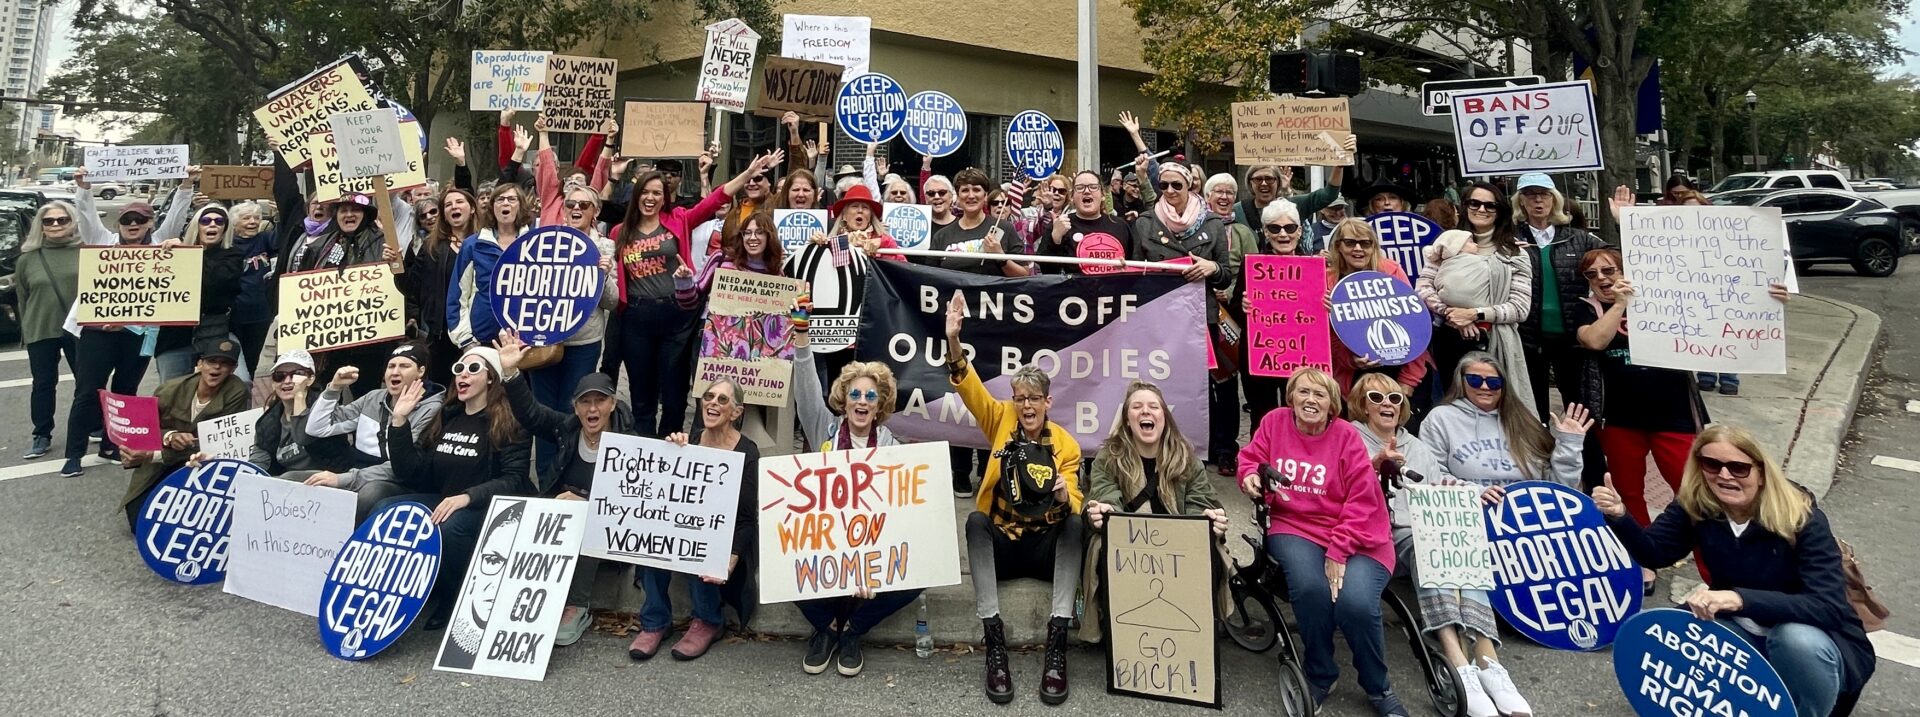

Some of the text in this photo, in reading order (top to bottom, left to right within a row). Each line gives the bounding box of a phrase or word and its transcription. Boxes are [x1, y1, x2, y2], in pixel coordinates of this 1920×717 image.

[794, 21, 820, 31] Where
[730, 34, 749, 50] WILL
[475, 52, 544, 68] Reproductive
[711, 46, 751, 67] NEVER
[492, 64, 530, 82] Rights
[550, 58, 614, 76] NO WOMAN
[474, 77, 545, 92] are Human
[554, 73, 607, 88] CAN CALL
[764, 68, 843, 106] VASECTOMY
[850, 75, 892, 95] KEEP
[268, 70, 342, 113] QUAKERS
[489, 90, 544, 110] Rights!
[545, 86, 611, 99] HERSELF FREE
[544, 98, 584, 108] WHEN SHE
[840, 93, 904, 115] ABORTION
[915, 94, 953, 111] KEEP
[1237, 102, 1346, 117] ONE will
[1464, 92, 1550, 114] BANS
[269, 100, 315, 128] UNITE
[346, 114, 372, 126] KEEP
[545, 108, 611, 118] CONTROL HER
[847, 112, 900, 132] LEGAL
[905, 109, 963, 131] ABORTION
[1017, 114, 1049, 131] KEEP
[1237, 115, 1344, 130] have an ABORTION
[360, 126, 383, 134] YOUR
[546, 118, 605, 132] OWN BODY
[1251, 130, 1274, 140] their
[1470, 113, 1589, 137] OFF OUR
[350, 136, 378, 145] LAWS
[910, 128, 958, 146] LEGAL
[1010, 131, 1060, 150] ABORTION
[98, 156, 178, 167] STILL MARCHING
[118, 148, 150, 156] BELIEVE
[378, 153, 393, 162] MY
[1017, 149, 1058, 169] LEGAL
[126, 168, 149, 176] THIS
[355, 164, 381, 176] BODY
[211, 173, 257, 189] TRUST
[786, 213, 816, 226] KEEP
[894, 207, 920, 218] KEEP
[887, 217, 927, 230] ABORTION
[1629, 211, 1754, 240] I'm no longer
[889, 228, 924, 242] LEGAL
[100, 249, 174, 261] QUAKERS
[520, 231, 587, 263] KEEP
[1631, 234, 1775, 258] accepting the
[98, 262, 146, 274] UNITE
[1254, 262, 1301, 281] Still
[1627, 249, 1764, 275] things I can
[94, 275, 175, 290] WOMENS'
[298, 269, 382, 290] QUAKERS
[496, 264, 598, 298] ABORTION
[720, 275, 755, 286] NEED AN
[1631, 267, 1664, 280] not
[80, 291, 190, 305] REPRODUCTIVE
[300, 285, 352, 302] UNITE
[730, 284, 757, 294] TAMPA
[760, 288, 780, 298] BAY?
[1254, 289, 1298, 300] in the
[1345, 277, 1395, 299] ELECT
[1632, 285, 1754, 310] changing the
[95, 305, 155, 318] RIGHTS
[296, 295, 388, 320] WOMENS'
[503, 298, 583, 332] LEGAL
[1059, 294, 1138, 326] OFF
[1332, 295, 1422, 322] FEMINISTS
[1632, 300, 1782, 324] things cannot
[280, 309, 400, 337] REPRODUCTIVE
[1252, 310, 1316, 327] fight for
[306, 326, 377, 349] RIGHTS
[1254, 332, 1306, 354] Legal
[1637, 320, 1783, 350] accept Angela
[703, 363, 761, 377] TAMPA BAY
[1001, 346, 1172, 379] BODIES
[758, 379, 784, 389] FUND
[214, 416, 237, 430] THE
[207, 424, 250, 443] FUTURE
[224, 440, 234, 449] IS
[454, 445, 478, 457] Care.
[602, 447, 656, 483] Right
[658, 457, 671, 473] to
[1276, 458, 1326, 486] 1973
[669, 483, 706, 504] LIE!
[786, 463, 930, 514] STOP THE
[261, 489, 321, 523] Babies??
[1409, 490, 1479, 508] ANOTHER
[595, 497, 725, 530] They care if
[1423, 510, 1481, 527] MOTHER
[1487, 487, 1583, 536] KEEP
[368, 505, 435, 549] KEEP
[533, 513, 573, 546] WE
[778, 512, 886, 555] WAR ON
[1128, 519, 1168, 546] We
[247, 531, 289, 553] In this
[605, 527, 708, 558] WOMEN DIE
[1441, 530, 1470, 548] FOR
[1116, 549, 1186, 578] WONT
[1429, 550, 1490, 569] CHOICE
[1487, 525, 1632, 586] ABORTION
[331, 540, 437, 599] ABORTION
[509, 551, 574, 583] WON'T
[795, 542, 909, 593] WOMEN
[326, 585, 406, 641] LEGAL
[510, 587, 547, 623] GO
[1505, 576, 1632, 632] LEGAL
[487, 630, 545, 664] BACK
[1139, 632, 1176, 661] GO
[1685, 623, 1750, 669] SAFE
[1644, 623, 1782, 711] ABORTION
[1690, 665, 1721, 693] IS A
